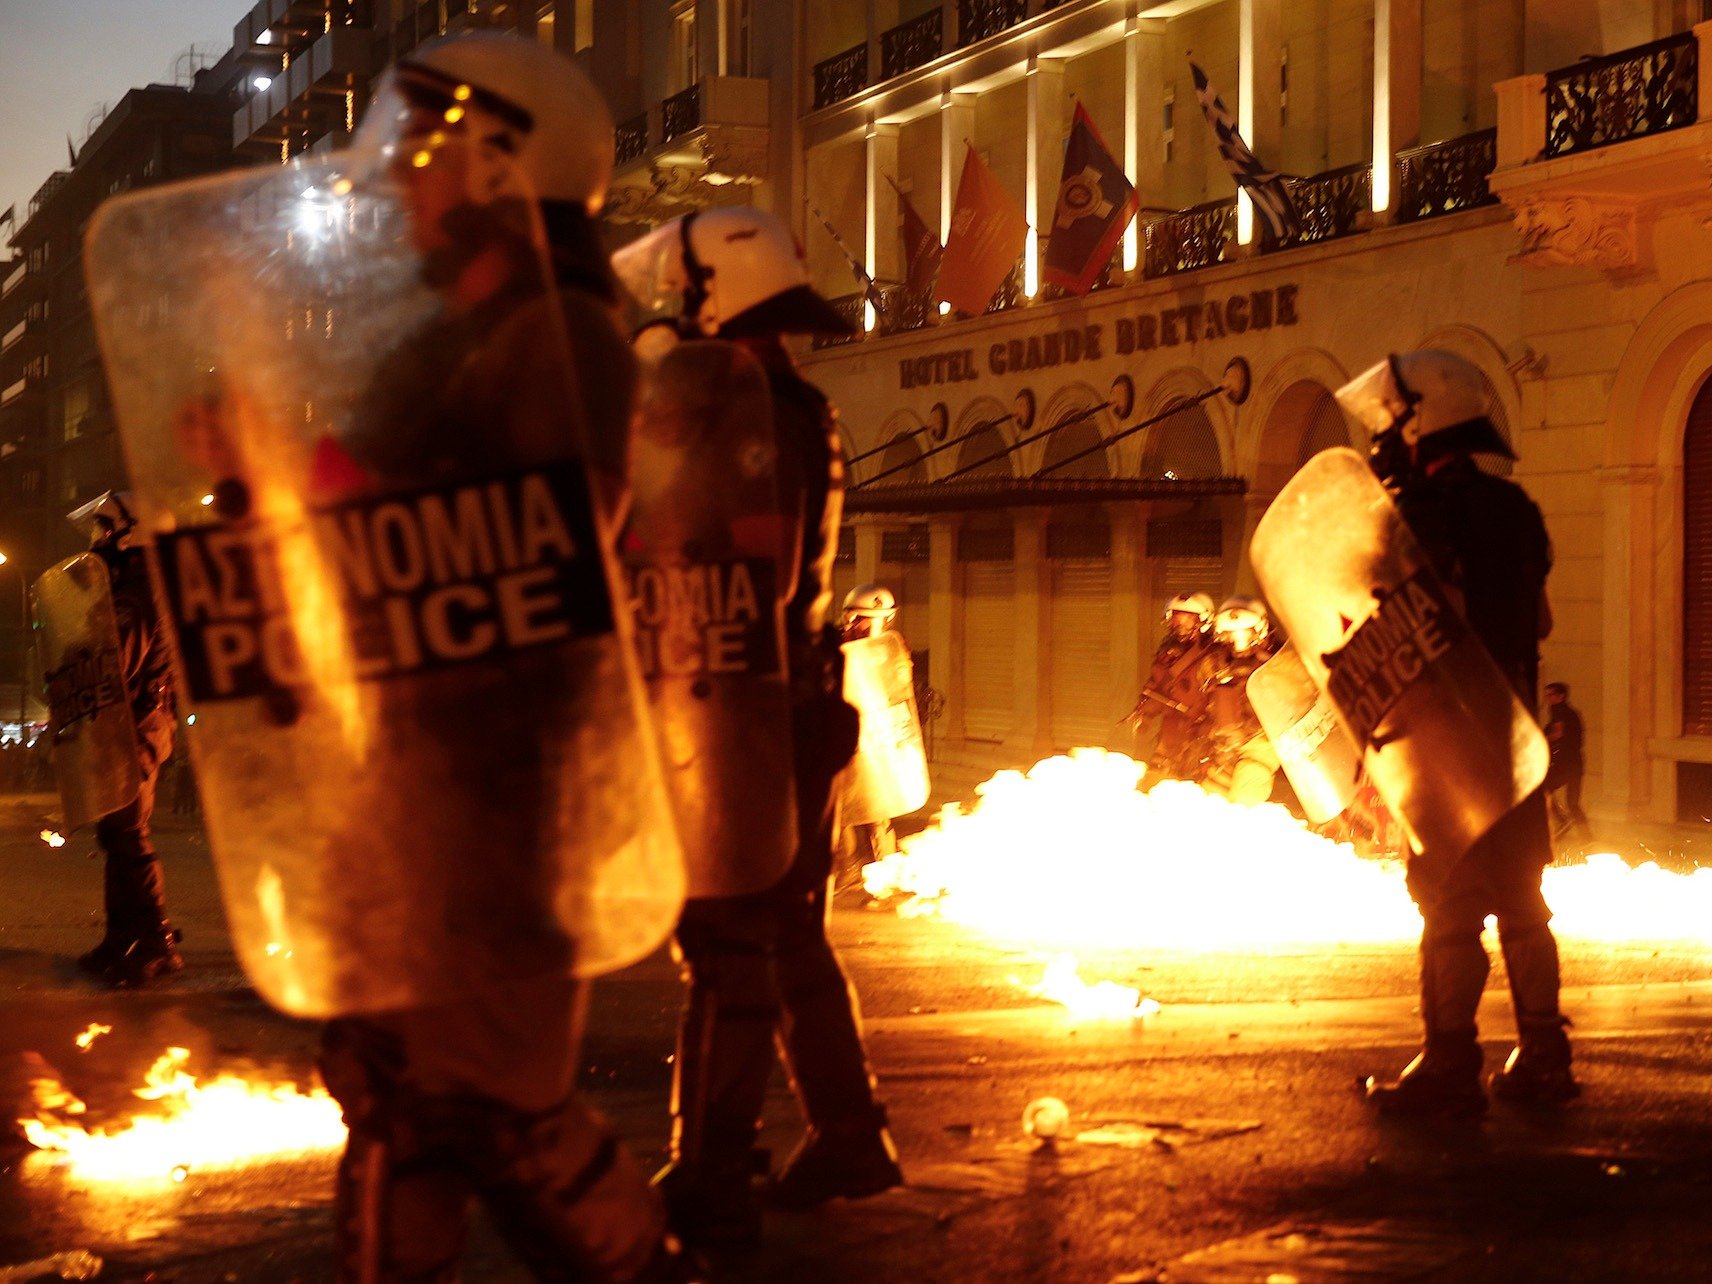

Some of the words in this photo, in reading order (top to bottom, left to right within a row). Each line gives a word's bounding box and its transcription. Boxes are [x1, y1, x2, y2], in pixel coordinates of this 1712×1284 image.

[899, 348, 979, 389] HOTEL
[989, 324, 1102, 375] GRANDE
[1115, 284, 1299, 355] BRETAGNE
[176, 473, 576, 624] ΑΣΤΝΟΜΙΑ
[1354, 619, 1452, 730] OLICE
